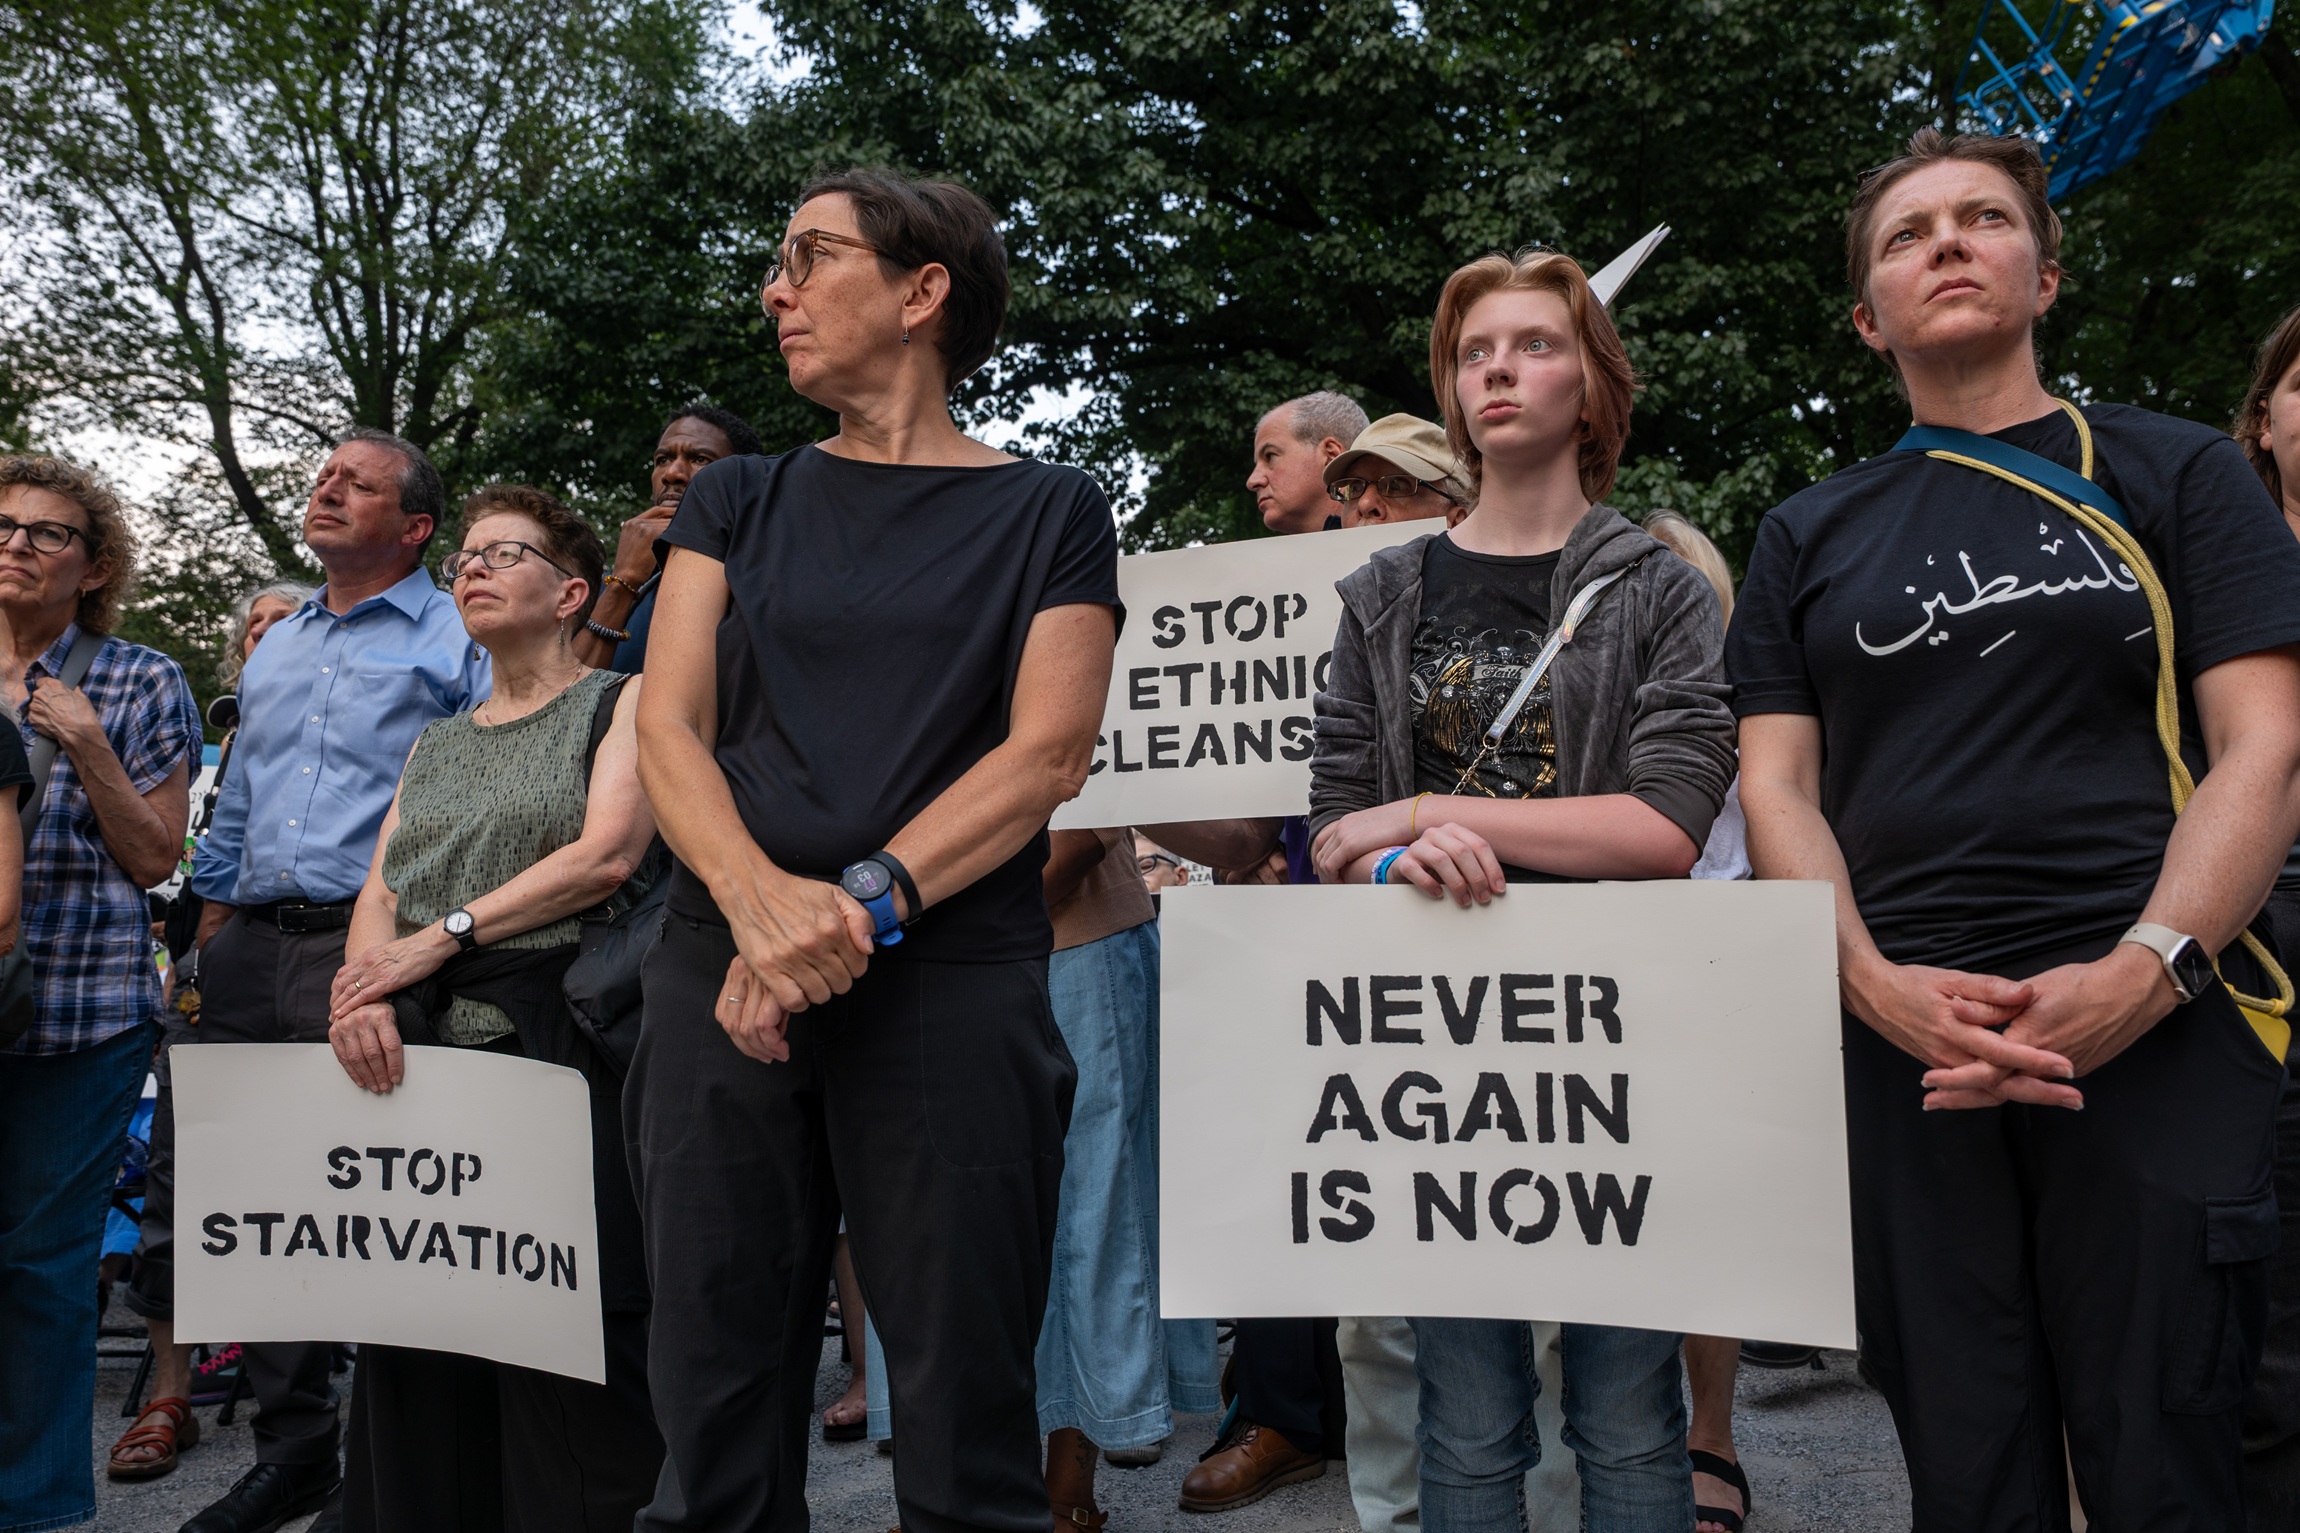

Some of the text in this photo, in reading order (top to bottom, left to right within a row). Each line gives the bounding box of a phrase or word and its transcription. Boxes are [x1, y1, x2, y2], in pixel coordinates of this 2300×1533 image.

[1152, 593, 1307, 649] STOP
[1306, 974, 1622, 1045] NEVER
[1306, 1071, 1630, 1144] AGAIN
[327, 1146, 482, 1196] STOP
[1291, 1168, 1652, 1246] IS NOW
[201, 1212, 577, 1291] STARVATION
